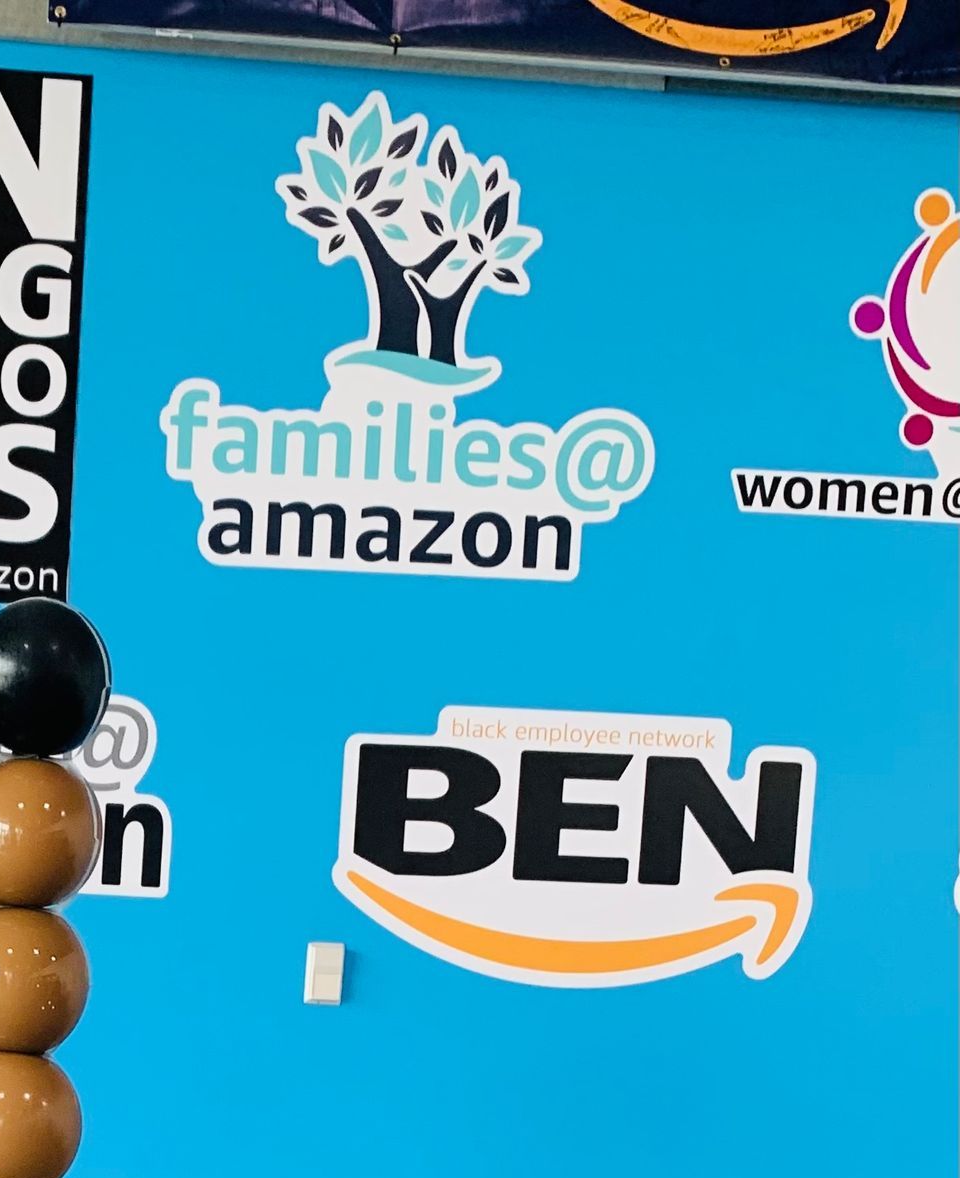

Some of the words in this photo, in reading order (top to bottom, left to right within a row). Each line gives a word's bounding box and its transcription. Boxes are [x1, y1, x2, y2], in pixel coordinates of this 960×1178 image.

[170, 389, 645, 512] families@
[207, 498, 573, 571] amazon
[451, 718, 507, 739] black
[515, 723, 621, 748] employee
[629, 730, 716, 749] network
[353, 743, 803, 885] BEN
